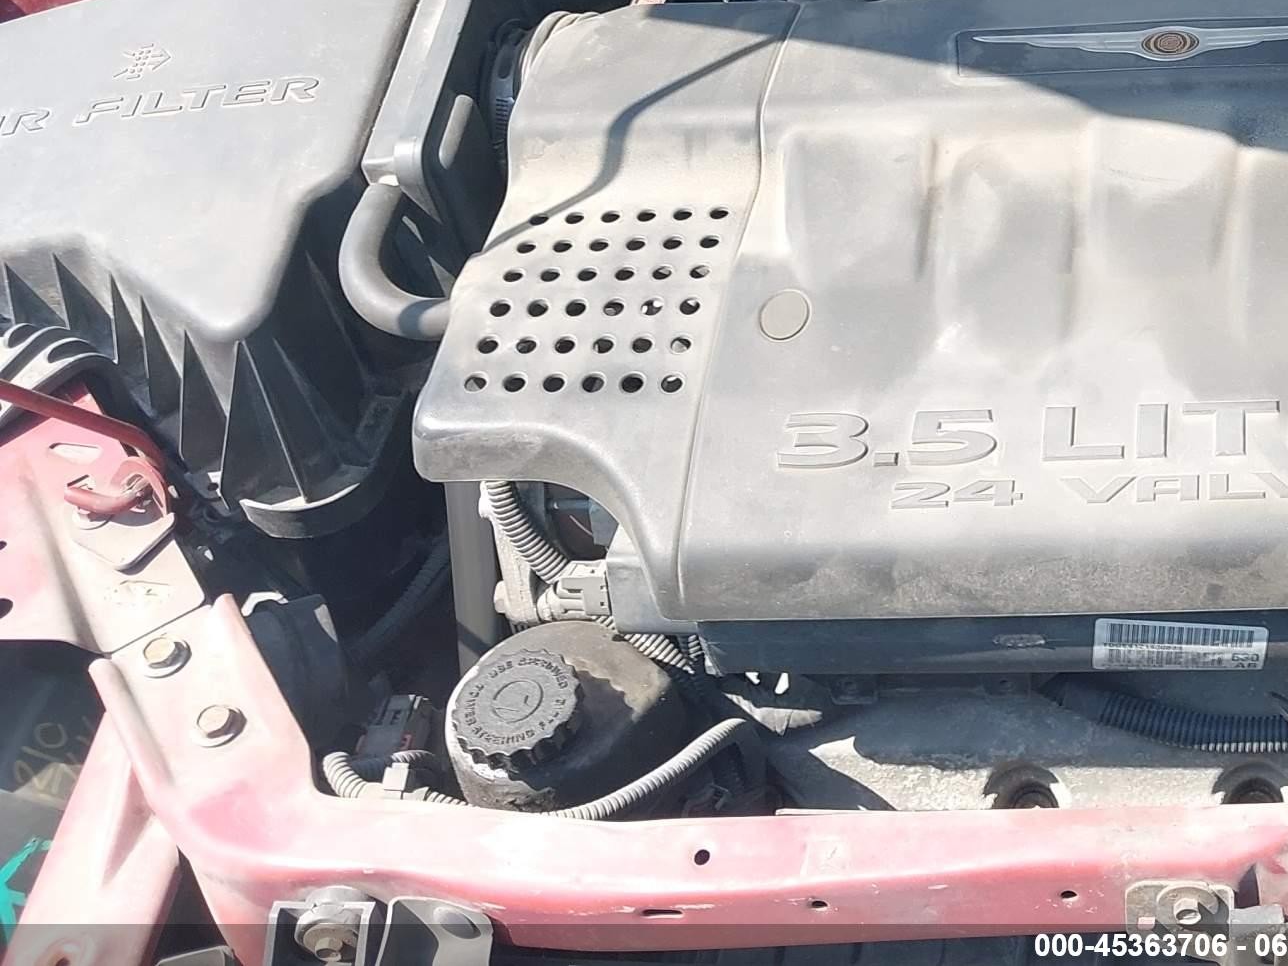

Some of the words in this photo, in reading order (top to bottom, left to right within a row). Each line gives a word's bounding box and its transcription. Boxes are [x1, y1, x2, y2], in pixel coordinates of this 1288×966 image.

[72, 76, 320, 126] FILTER
[776, 407, 998, 470] 3.5
[888, 477, 1025, 511] 24
[488, 660, 514, 678] USE
[464, 683, 485, 727] POWER
[471, 725, 536, 745] STEERING
